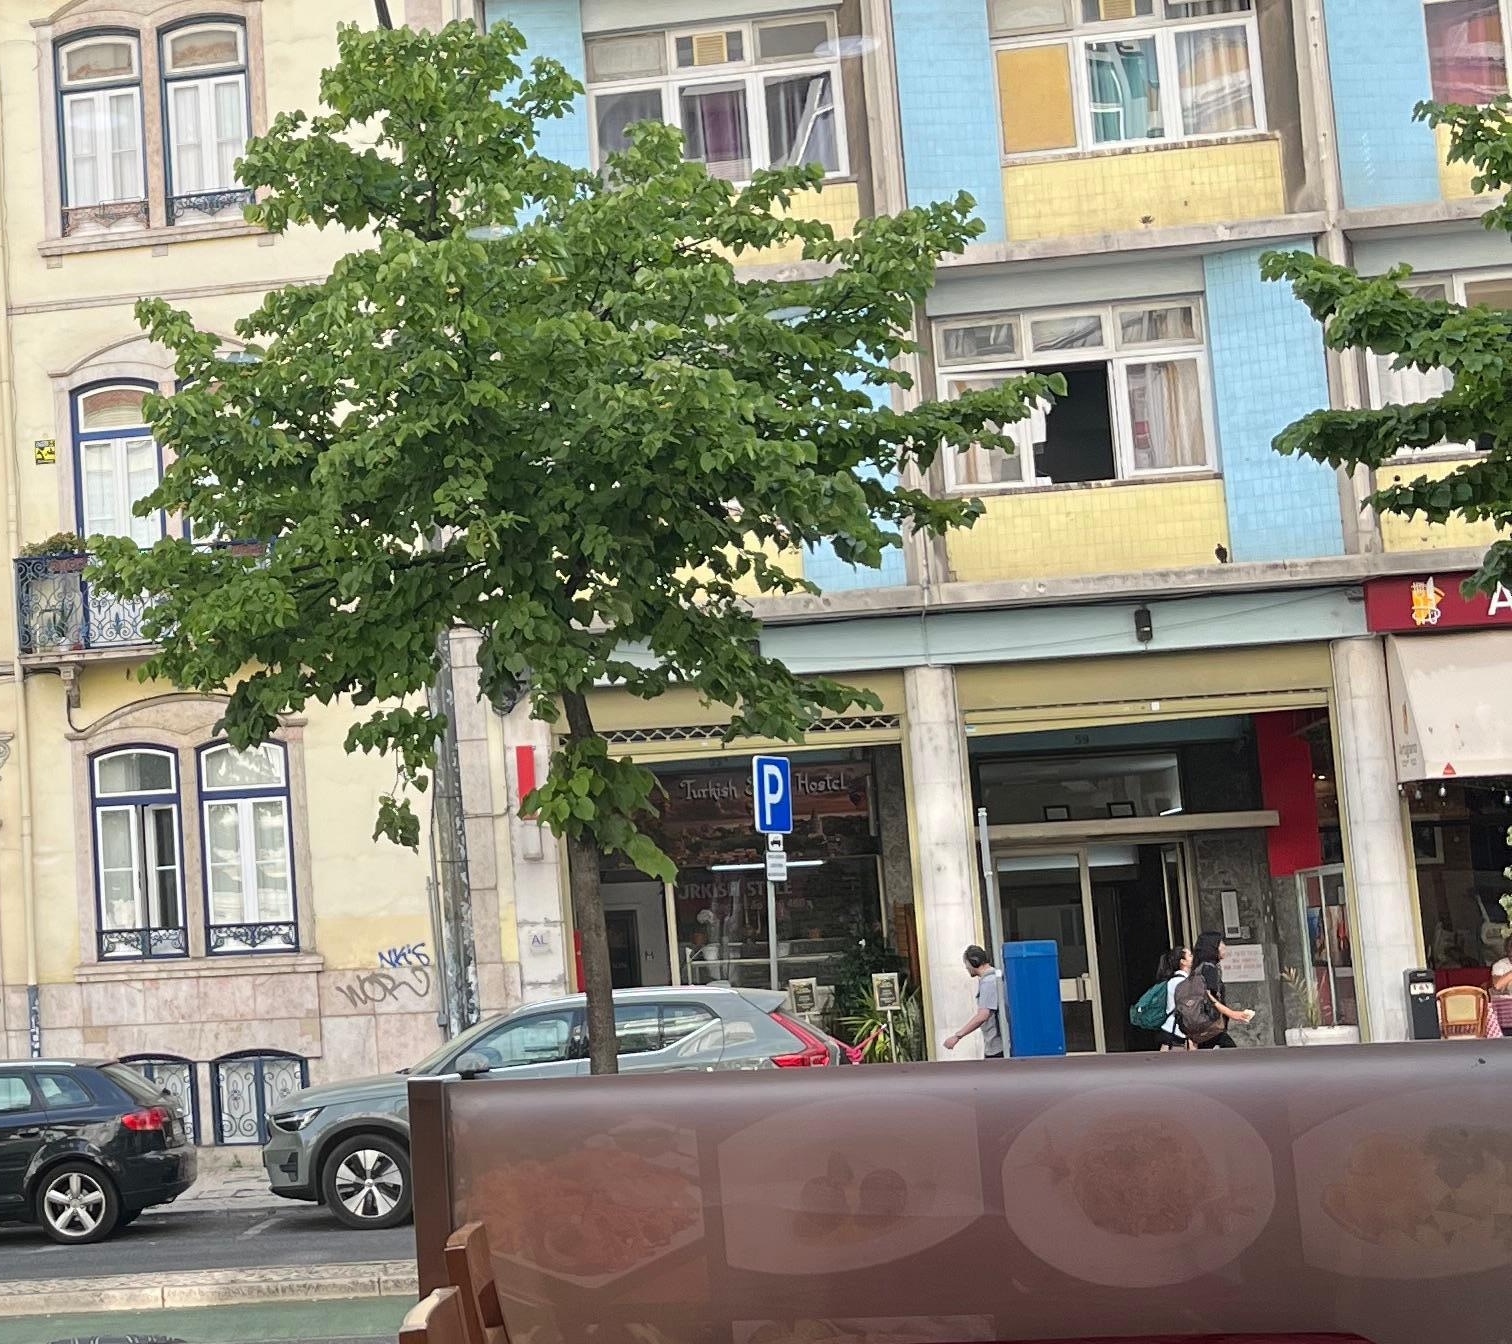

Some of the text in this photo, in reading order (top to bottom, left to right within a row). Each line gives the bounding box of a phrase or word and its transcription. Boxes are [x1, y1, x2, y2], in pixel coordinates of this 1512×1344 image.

[680, 777, 738, 801] Turkish
[796, 772, 847, 794] Hostel
[763, 764, 783, 825] P
[678, 880, 792, 899] URKISH STLE
